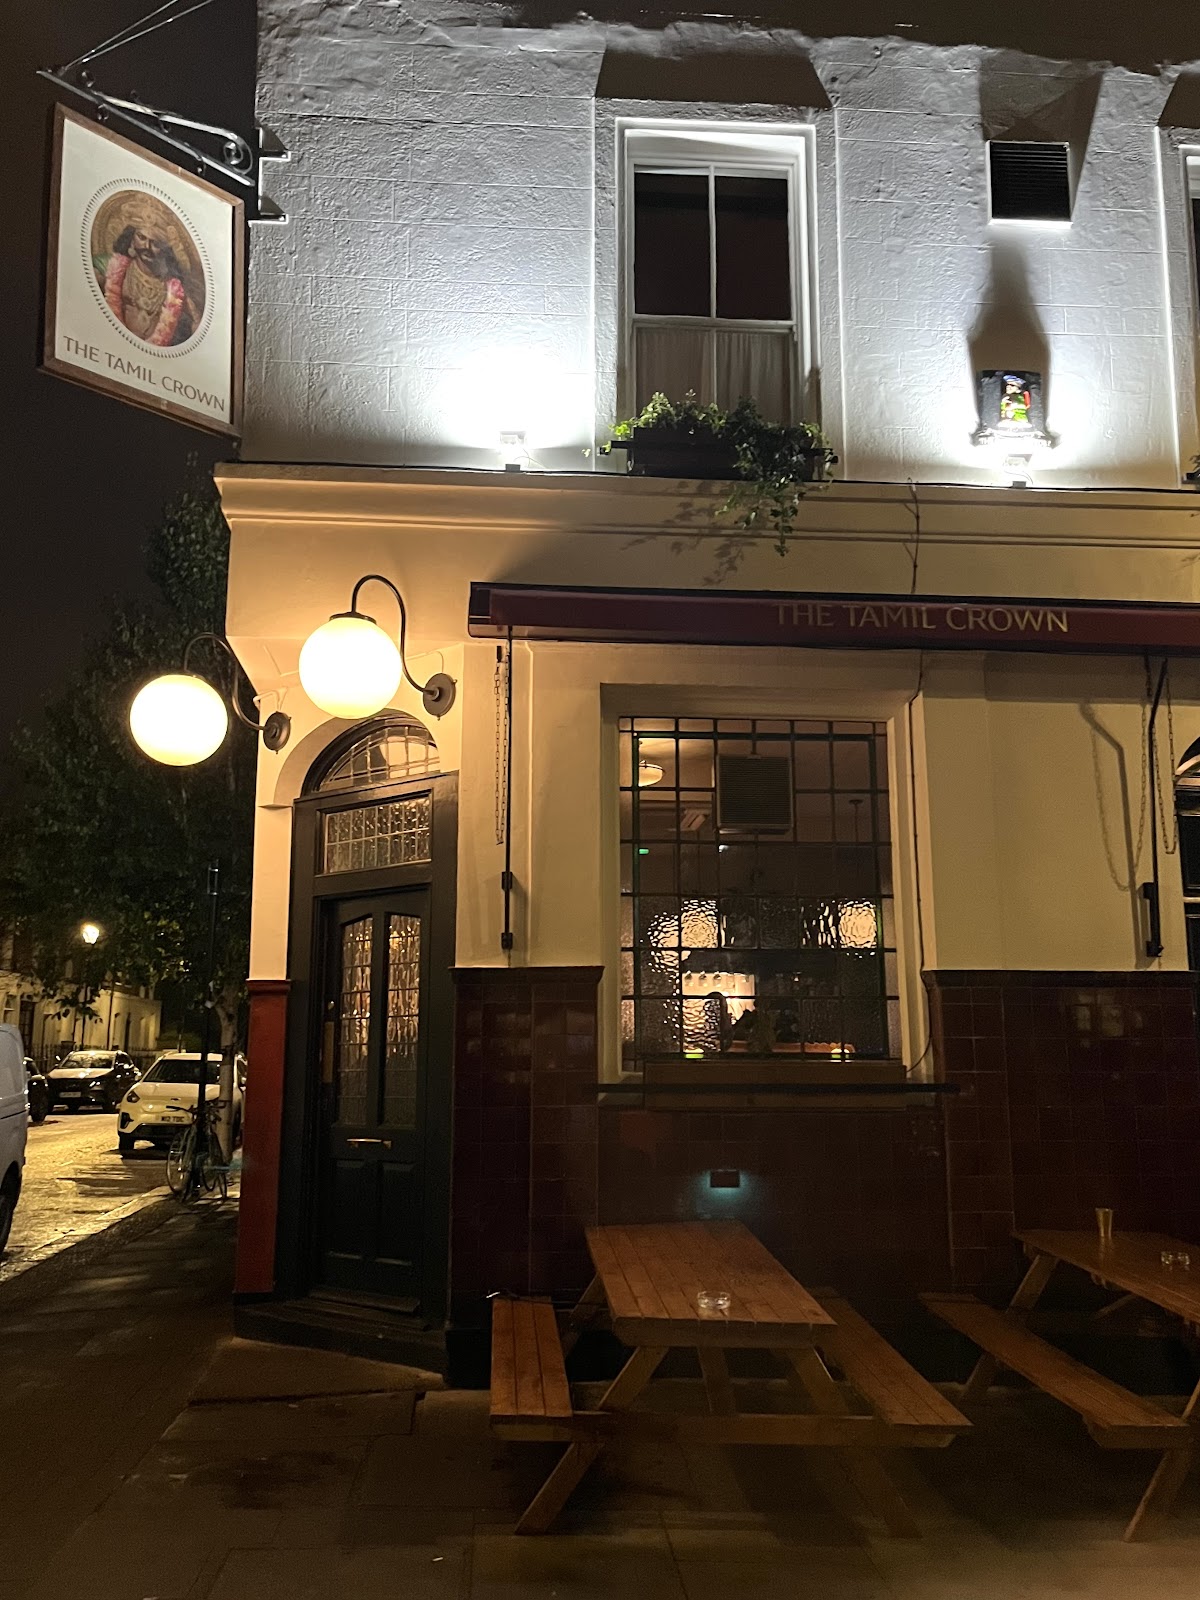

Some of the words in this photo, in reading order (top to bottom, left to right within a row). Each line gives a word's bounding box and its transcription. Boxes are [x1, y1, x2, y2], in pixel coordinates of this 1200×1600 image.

[63, 335, 100, 363] THE
[105, 352, 156, 385] TAMIL
[161, 376, 225, 412] CROWN
[773, 603, 834, 628] THE
[837, 604, 937, 630] TAMIL
[945, 606, 1069, 633] CROWN
